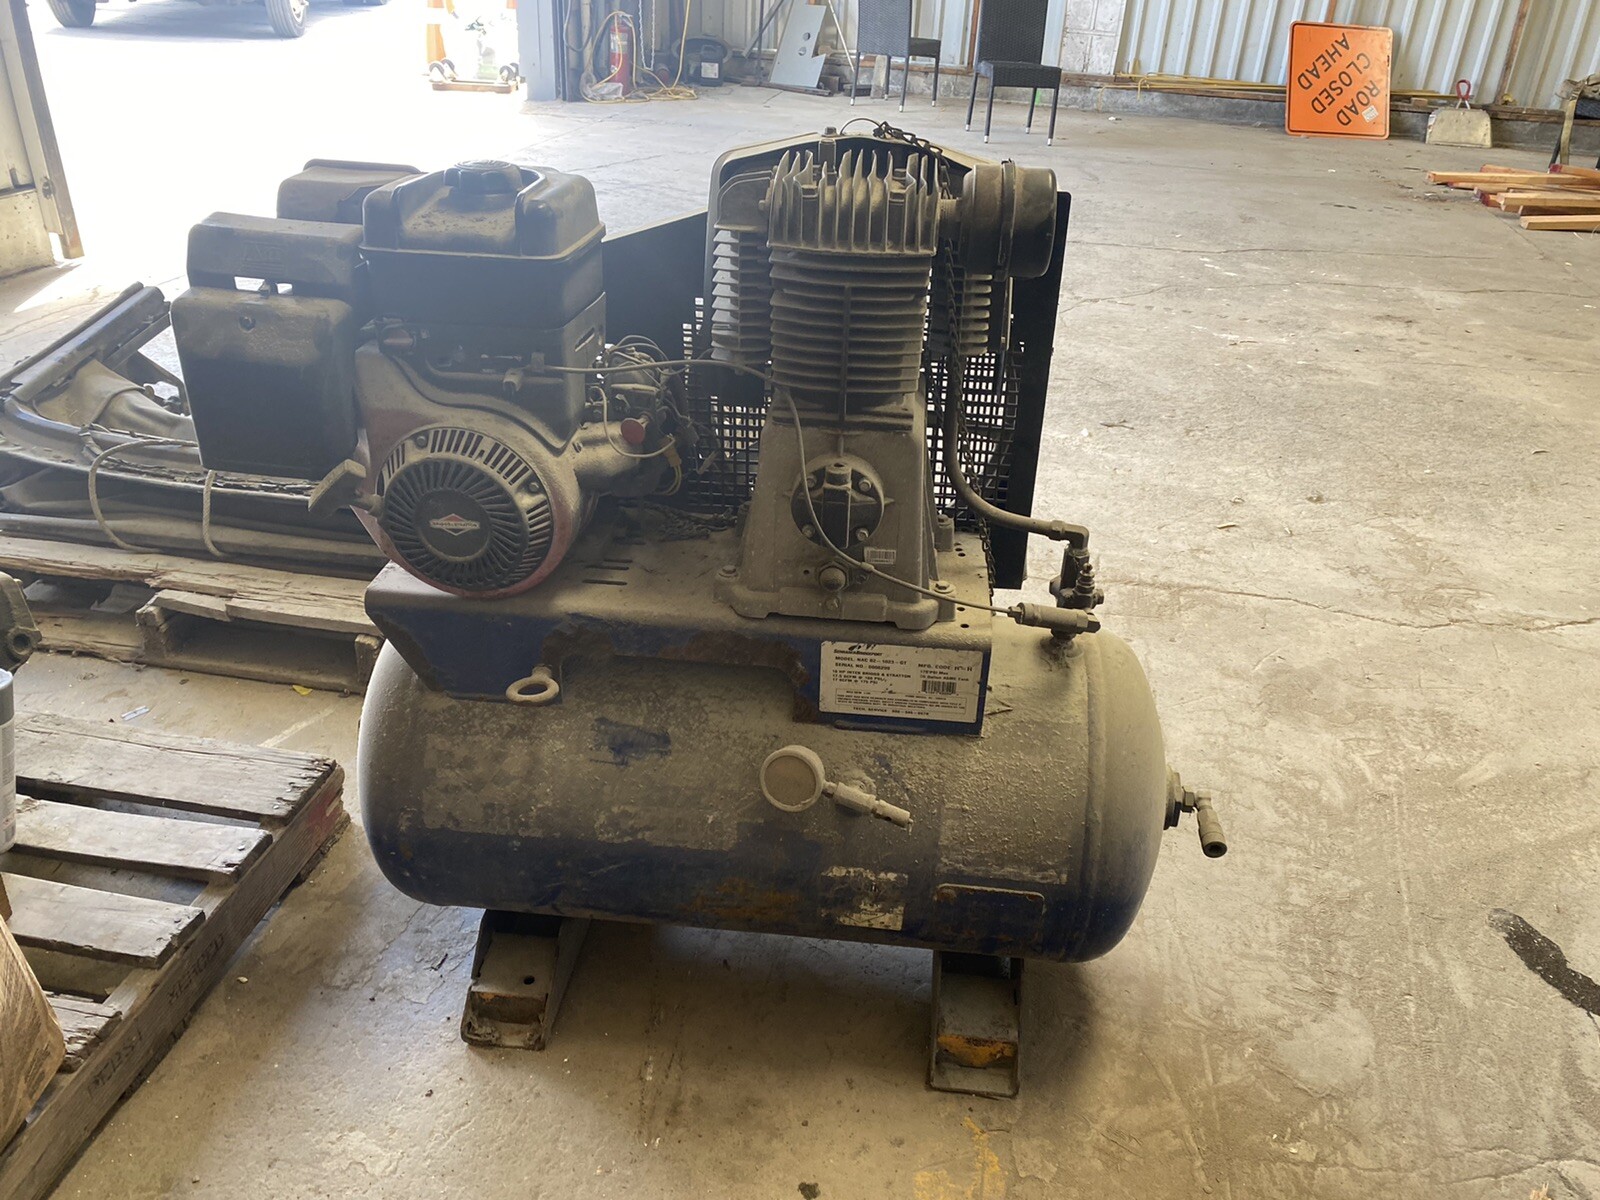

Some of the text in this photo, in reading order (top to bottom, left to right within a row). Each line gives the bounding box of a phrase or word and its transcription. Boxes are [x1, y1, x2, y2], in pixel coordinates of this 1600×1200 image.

[1297, 33, 1350, 90] AHEAD
[1311, 52, 1371, 114] CLOSED
[1337, 80, 1380, 126] ROAD
